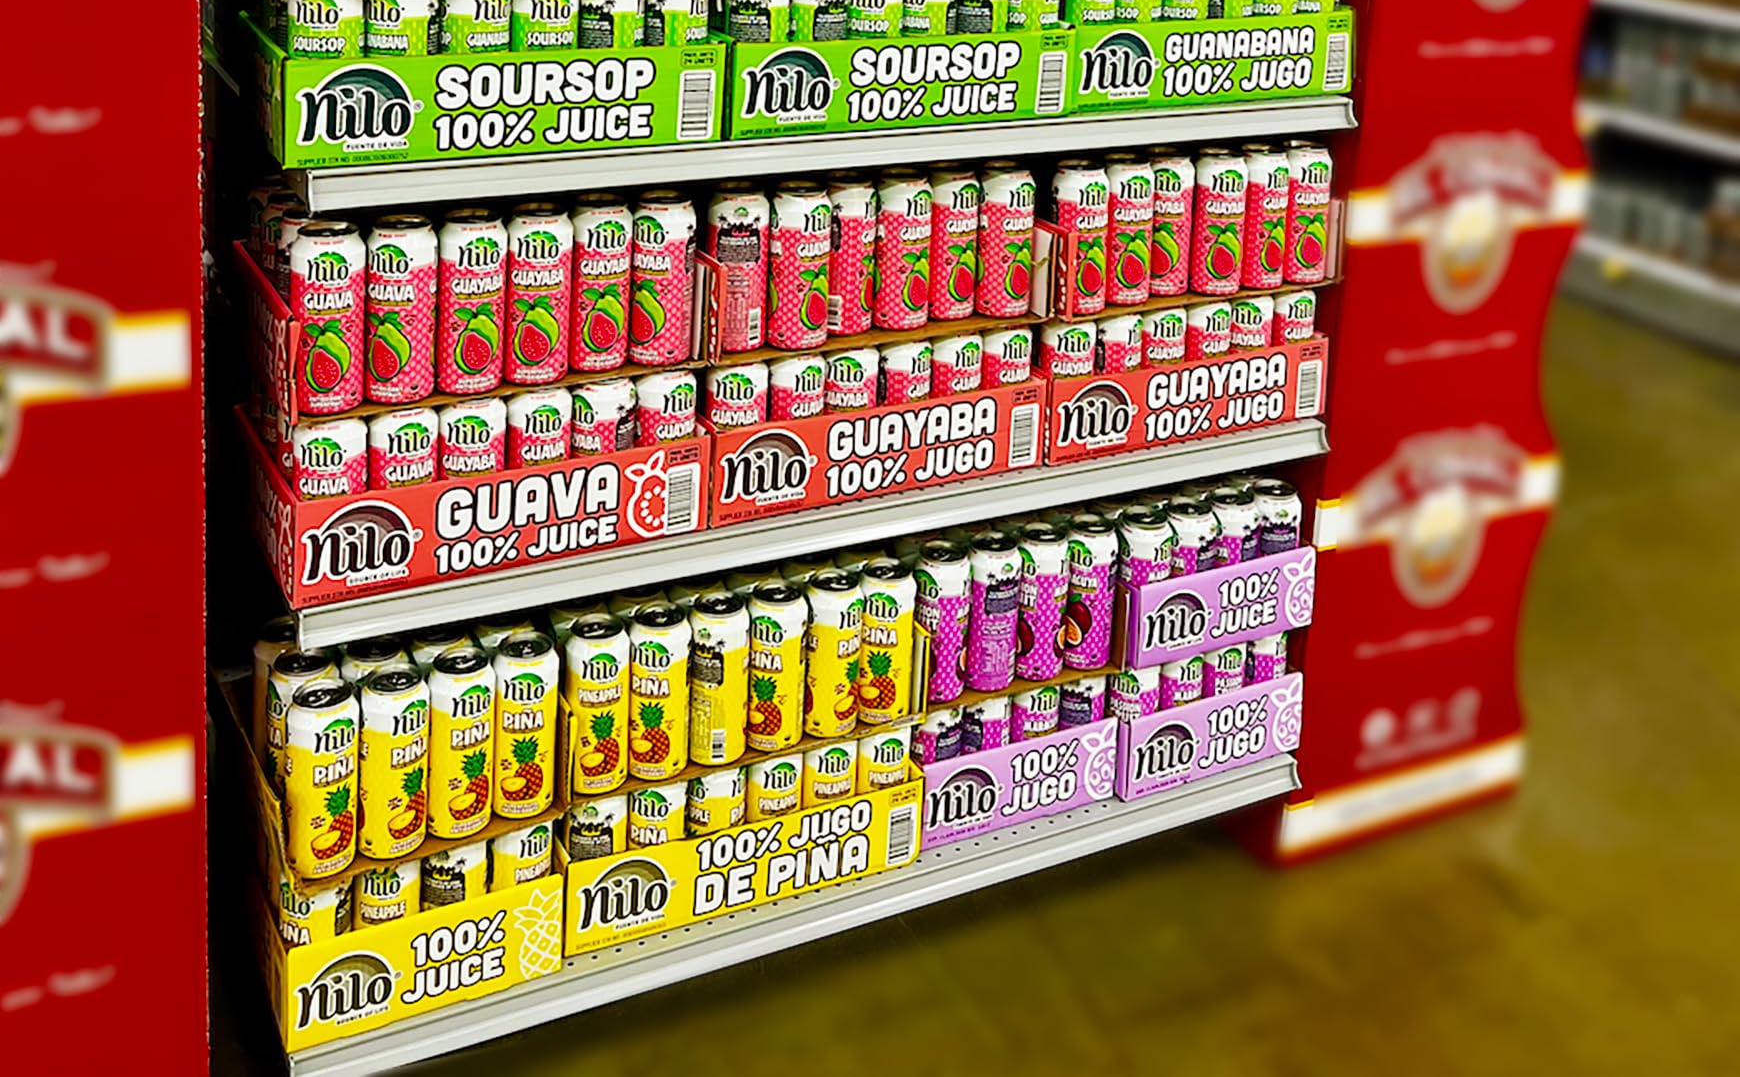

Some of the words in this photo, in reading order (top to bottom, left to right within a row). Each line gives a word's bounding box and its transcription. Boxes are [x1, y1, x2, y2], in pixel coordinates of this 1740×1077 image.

[296, 1, 339, 26] nilo
[293, 35, 346, 51] SOURSOP
[1165, 25, 1315, 63] GUANABANA
[849, 42, 1022, 87] SOURSOP
[1082, 48, 1153, 92] nilo
[1163, 61, 1236, 98] 100%
[1240, 57, 1313, 92] JUGO
[435, 57, 656, 110] SOURSOP
[746, 66, 833, 115] nilo
[301, 87, 411, 143] nilo
[847, 86, 928, 123] 100%
[931, 82, 1018, 117] JUICE
[434, 108, 537, 151] 100%
[543, 103, 653, 144] JUICE
[516, 236, 559, 260] nilo
[587, 228, 628, 250] nilo
[306, 258, 350, 283] nilo
[370, 250, 410, 275] nilo
[458, 245, 501, 268] nilo
[511, 267, 564, 286] GUAYABA
[303, 291, 354, 310] GUAVA
[368, 284, 415, 302] GUAVA
[1057, 335, 1091, 353] nilo
[716, 380, 754, 401] nilo
[1146, 353, 1288, 410] GUAYABA
[525, 413, 562, 434] nilo
[711, 409, 759, 424] GUAYABA
[826, 397, 998, 462] GUAYABA
[1058, 400, 1131, 444] nilo
[1144, 401, 1214, 442] 100%
[1217, 391, 1286, 429] JUGO
[387, 434, 431, 455] nilo
[448, 422, 490, 446] nilo
[302, 445, 343, 468] nilo
[443, 453, 496, 471] GUAYABA
[521, 442, 565, 460] GUAVA
[385, 462, 433, 482] GUAVA
[723, 450, 807, 503] nilo
[825, 453, 909, 499] 100%
[912, 438, 996, 482] JUGO
[300, 477, 350, 496] GUAVA
[435, 462, 620, 541] GUAVA
[305, 526, 412, 581] nilo
[434, 531, 521, 576] 100%
[526, 514, 618, 558] JUICE
[1218, 568, 1280, 609] 100%
[1144, 608, 1206, 649] nilo
[1210, 599, 1278, 638] JUICE
[582, 660, 619, 682] nilo
[632, 646, 670, 669] nilo
[503, 678, 546, 702] nilo
[577, 684, 622, 702] PINEAPPLE
[632, 675, 670, 696] PIÑA
[452, 693, 490, 718] nilo
[502, 709, 544, 730] PIÑA
[1206, 694, 1269, 738] 100%
[314, 726, 355, 754] nilo
[1198, 724, 1268, 770] JUGO
[818, 754, 850, 774] nilo
[1010, 738, 1080, 783] 100%
[1134, 735, 1194, 782] nilo
[762, 770, 797, 790] nilo
[1001, 770, 1078, 816] JUGO
[632, 795, 669, 818] nilo
[928, 784, 998, 828] nilo
[630, 824, 668, 844] PIÑA
[696, 822, 784, 871] 100%
[788, 800, 872, 849] JUGO
[692, 863, 758, 916] DE
[766, 833, 870, 896] PIÑA
[360, 902, 407, 920] PINEAPPLE
[580, 878, 669, 930] nilo
[411, 910, 508, 968] 100%
[401, 947, 506, 1005] JUICE
[297, 973, 393, 1029] nilo
